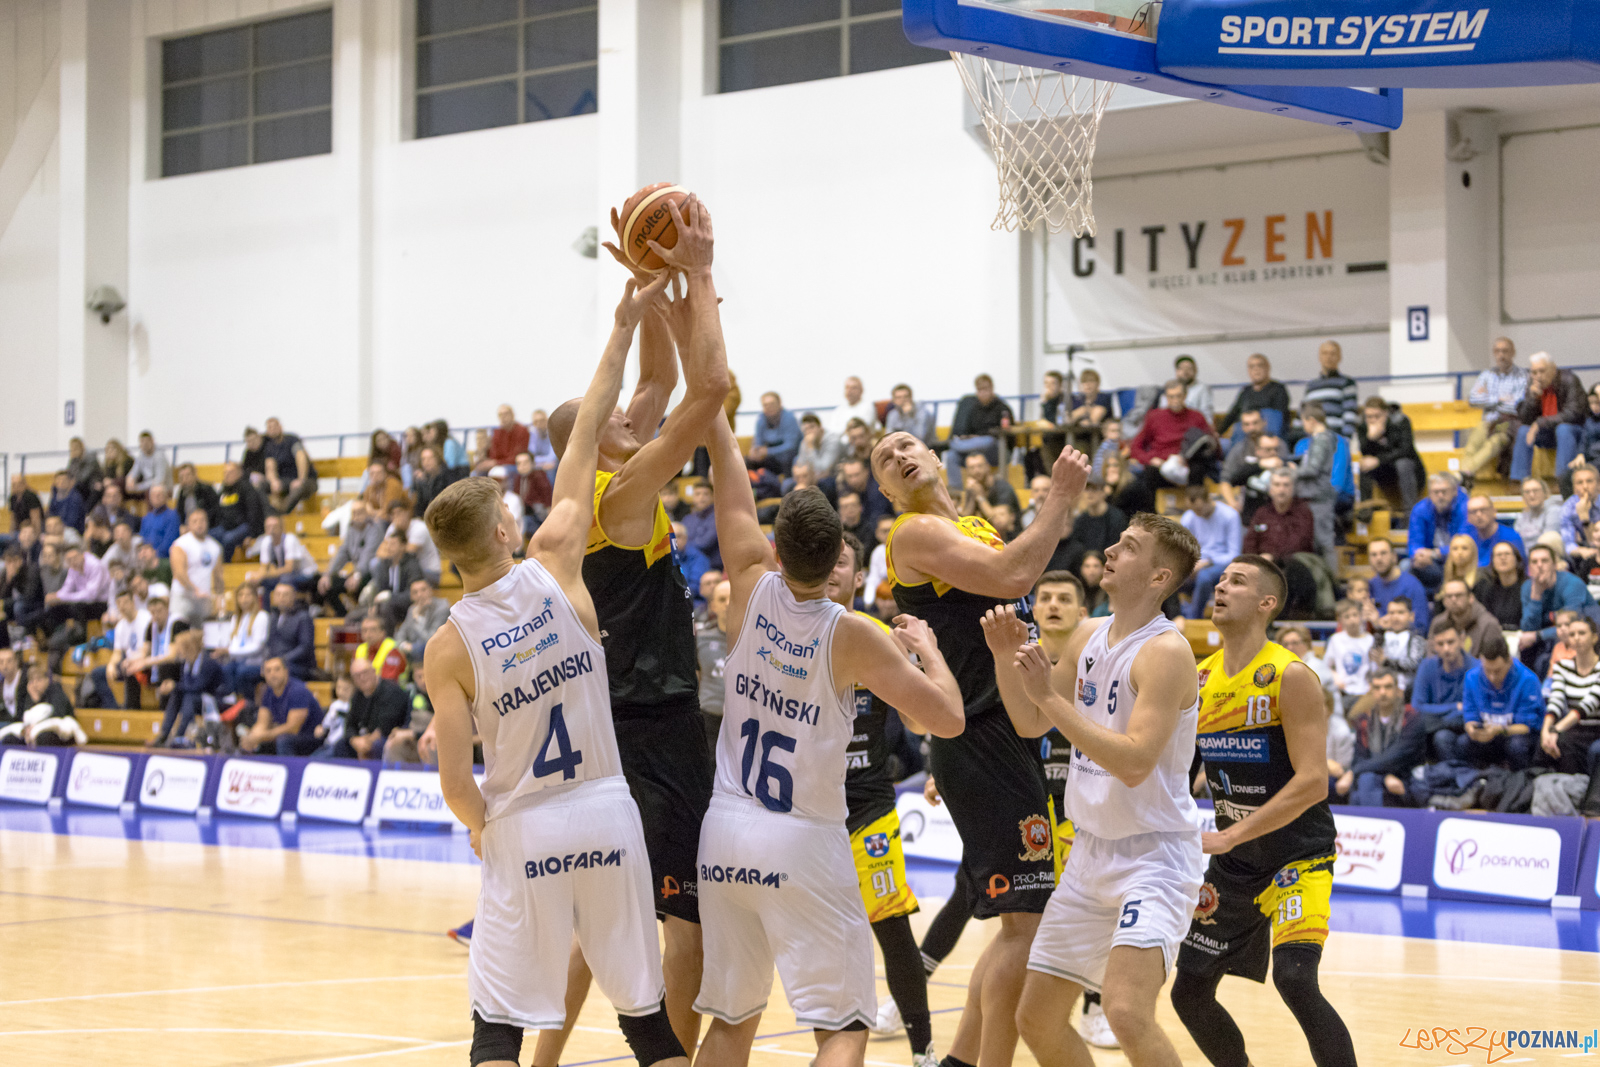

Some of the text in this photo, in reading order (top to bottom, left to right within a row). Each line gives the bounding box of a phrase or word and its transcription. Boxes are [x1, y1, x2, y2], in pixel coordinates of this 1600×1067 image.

[634, 202, 669, 249] molten
[1071, 209, 1334, 278] CITYZEN
[1223, 269, 1257, 283] KLUB
[1262, 264, 1335, 281] SPORTOWY
[1410, 310, 1426, 337] B
[515, 632, 559, 662] funclub
[735, 672, 821, 726] GIŻYŃSKI
[1107, 680, 1119, 715] 5
[1245, 694, 1272, 726] 18
[532, 702, 583, 782] 4
[741, 717, 797, 813] 16
[1231, 784, 1267, 794] TOWERS
[1479, 854, 1550, 870] posnania
[870, 866, 898, 899] 91
[1119, 899, 1143, 929] 5
[1277, 895, 1303, 926] 18
